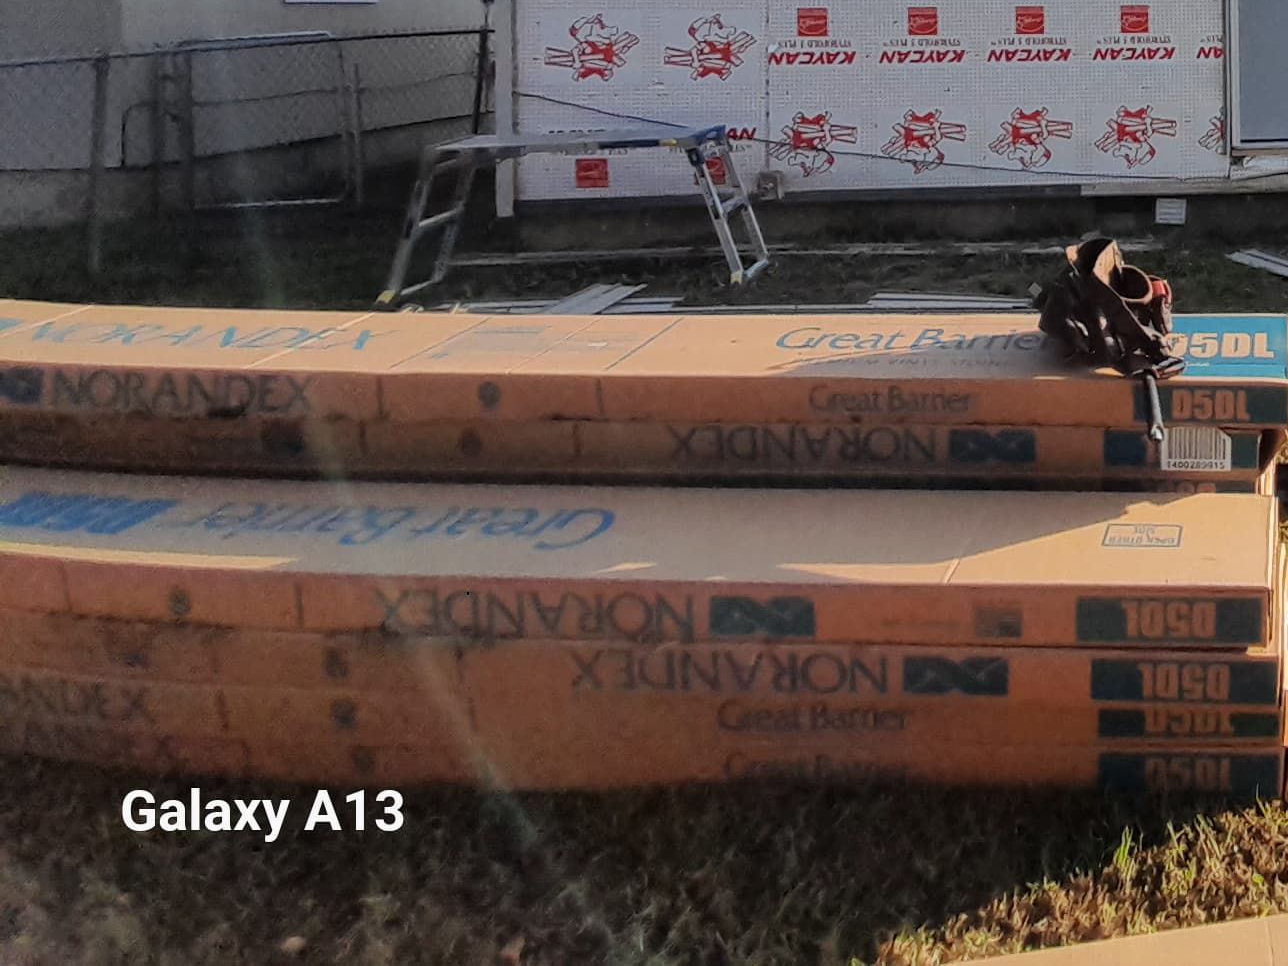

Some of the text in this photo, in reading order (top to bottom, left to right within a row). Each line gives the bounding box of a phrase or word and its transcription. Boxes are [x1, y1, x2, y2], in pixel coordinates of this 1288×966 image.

[768, 51, 857, 65] KAYCAN
[879, 50, 966, 64] KAYCAN
[987, 48, 1073, 62] KAYCAN
[1092, 47, 1176, 61] KAYCAN
[776, 327, 905, 351] Great
[52, 369, 314, 414] NORANDEX
[807, 382, 976, 415] Great Barrier
[672, 424, 938, 463] NORANDEX
[372, 587, 695, 643] NORANDEX
[566, 650, 888, 694] NORANDEX
